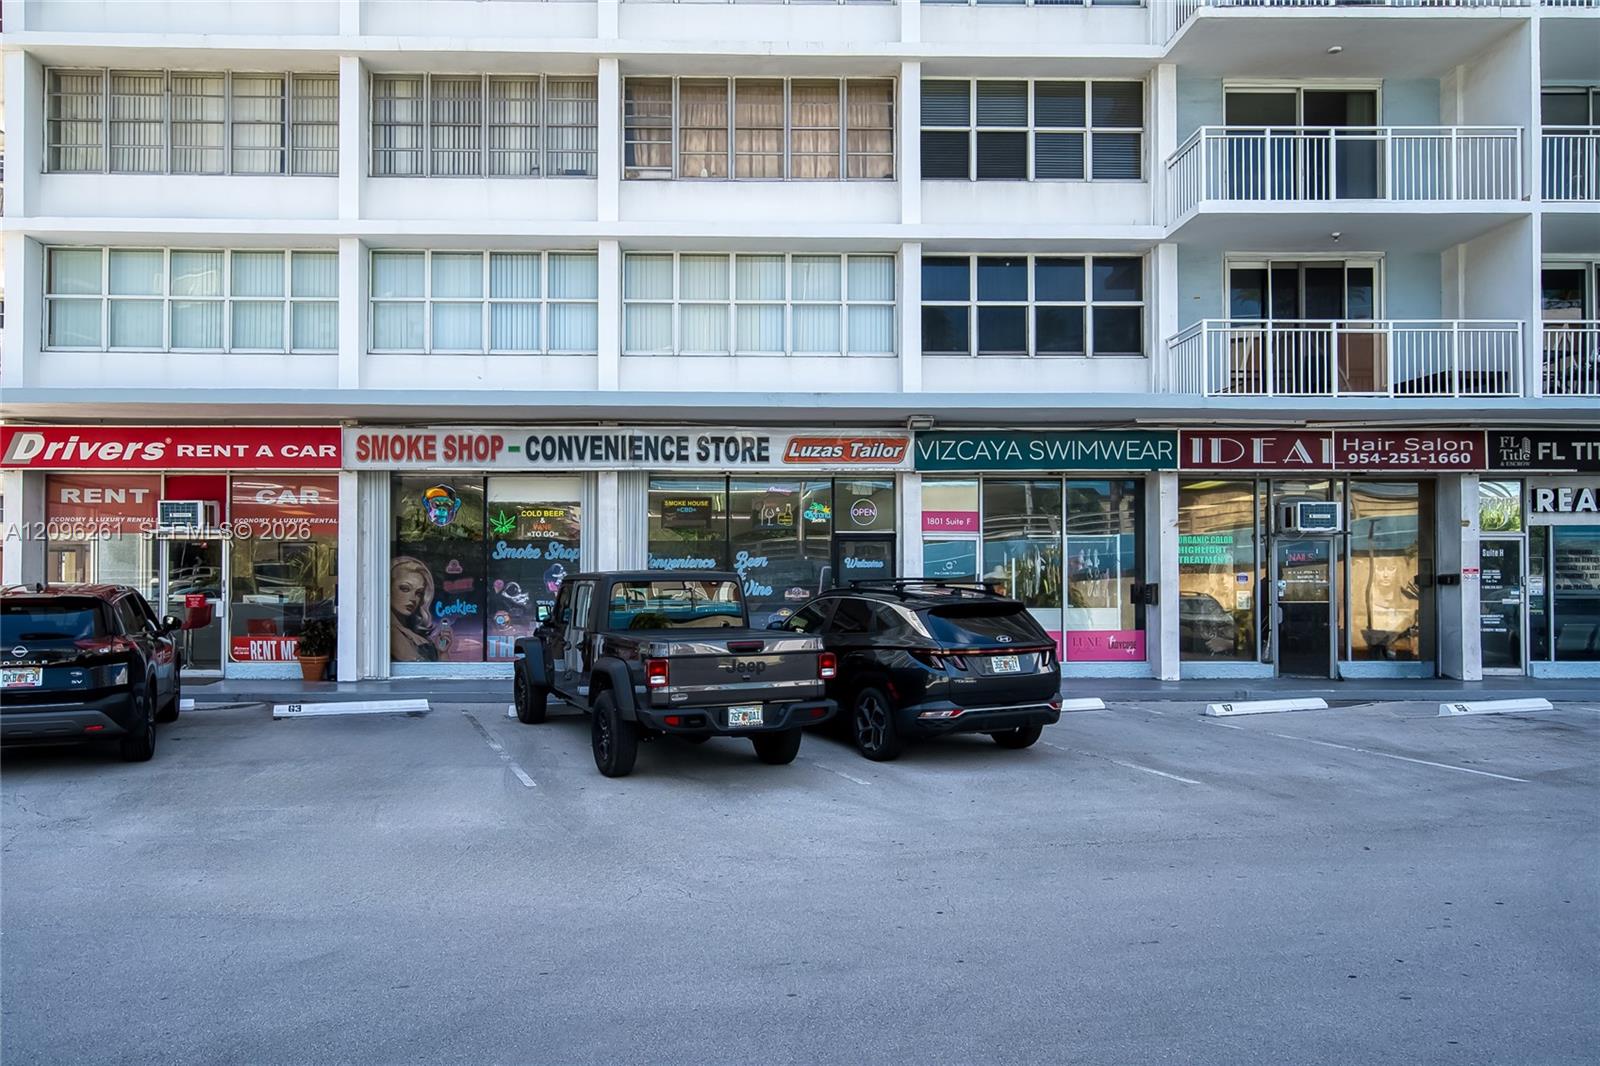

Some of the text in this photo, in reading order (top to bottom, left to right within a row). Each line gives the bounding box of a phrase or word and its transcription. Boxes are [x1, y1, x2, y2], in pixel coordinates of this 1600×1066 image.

[356, 434, 437, 462] SMOKE
[443, 434, 504, 462] SHOP
[525, 434, 689, 463] CONVENIENCE
[696, 434, 770, 463] STORE
[1343, 438, 1474, 451] Hair Salon
[1499, 436, 1520, 448] FL
[177, 445, 249, 457] RENT
[255, 445, 274, 457] A
[280, 445, 337, 457] CAR
[788, 441, 904, 459] Luzas Tailor
[917, 440, 1173, 460] VIZCAYA SWIMWEAR
[1499, 448, 1531, 460] Title
[1538, 442, 1566, 460] FL
[1348, 453, 1472, 464] 954-251-1660
[60, 488, 150, 504] RENT
[255, 489, 320, 504] CAR
[852, 508, 876, 517] OPEN
[927, 517, 943, 525] 1801
[945, 517, 964, 525] Suite
[492, 541, 580, 562] Smoke Shop
[1482, 548, 1499, 557] Suite
[734, 551, 769, 569] Beer
[844, 557, 884, 568] Welcome
[435, 599, 478, 618] Cookies
[250, 640, 277, 660] RENT
[726, 659, 766, 675] Jeep
